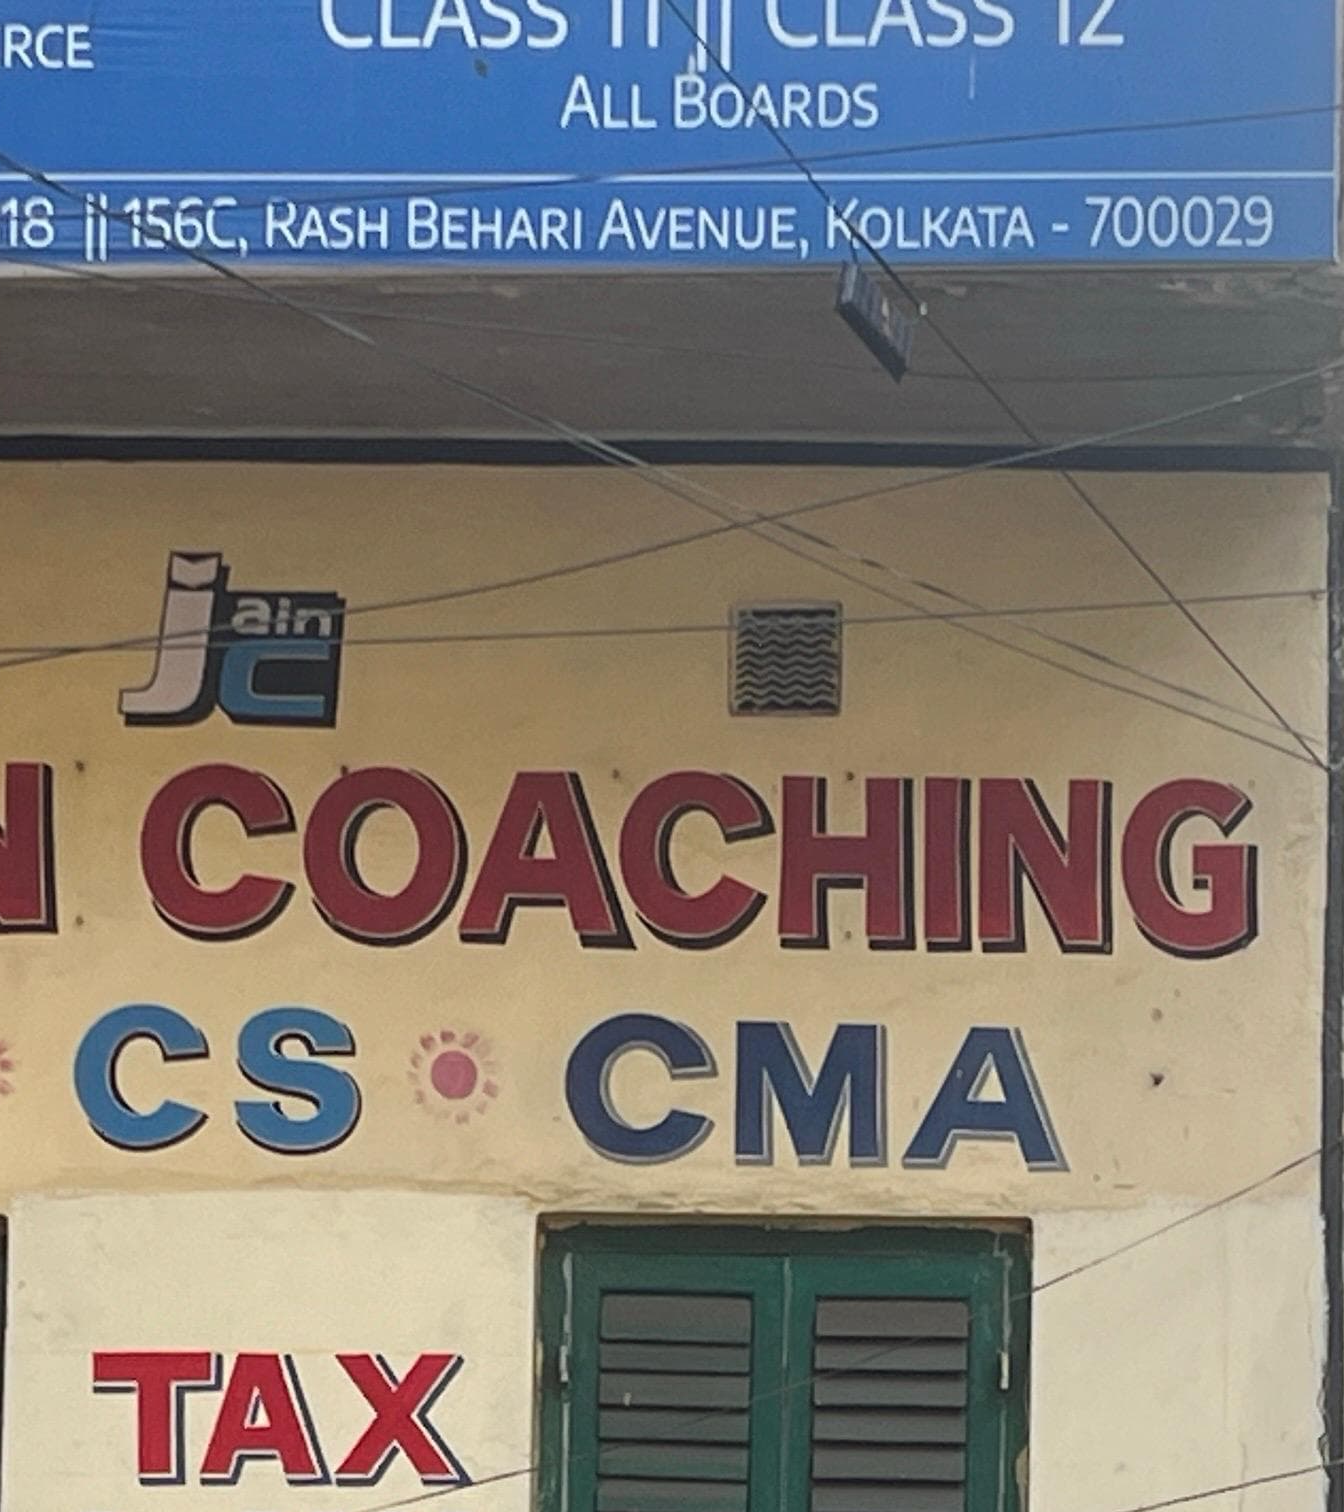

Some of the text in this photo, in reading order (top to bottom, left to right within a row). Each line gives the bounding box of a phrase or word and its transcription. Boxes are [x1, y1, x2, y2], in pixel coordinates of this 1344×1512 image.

[560, 74, 880, 129] ALL BOARDS
[125, 198, 248, 257] 156C,
[265, 198, 387, 250] RASH
[406, 198, 583, 251] BEHARI
[598, 199, 809, 258] AVENUE,
[827, 198, 1035, 250] KOLKATA
[1085, 196, 1273, 249] 700029
[140, 762, 1259, 962] COACHING
[74, 1003, 362, 1156] CS
[565, 1013, 1069, 1173] CMA
[92, 1351, 474, 1486] TAX
